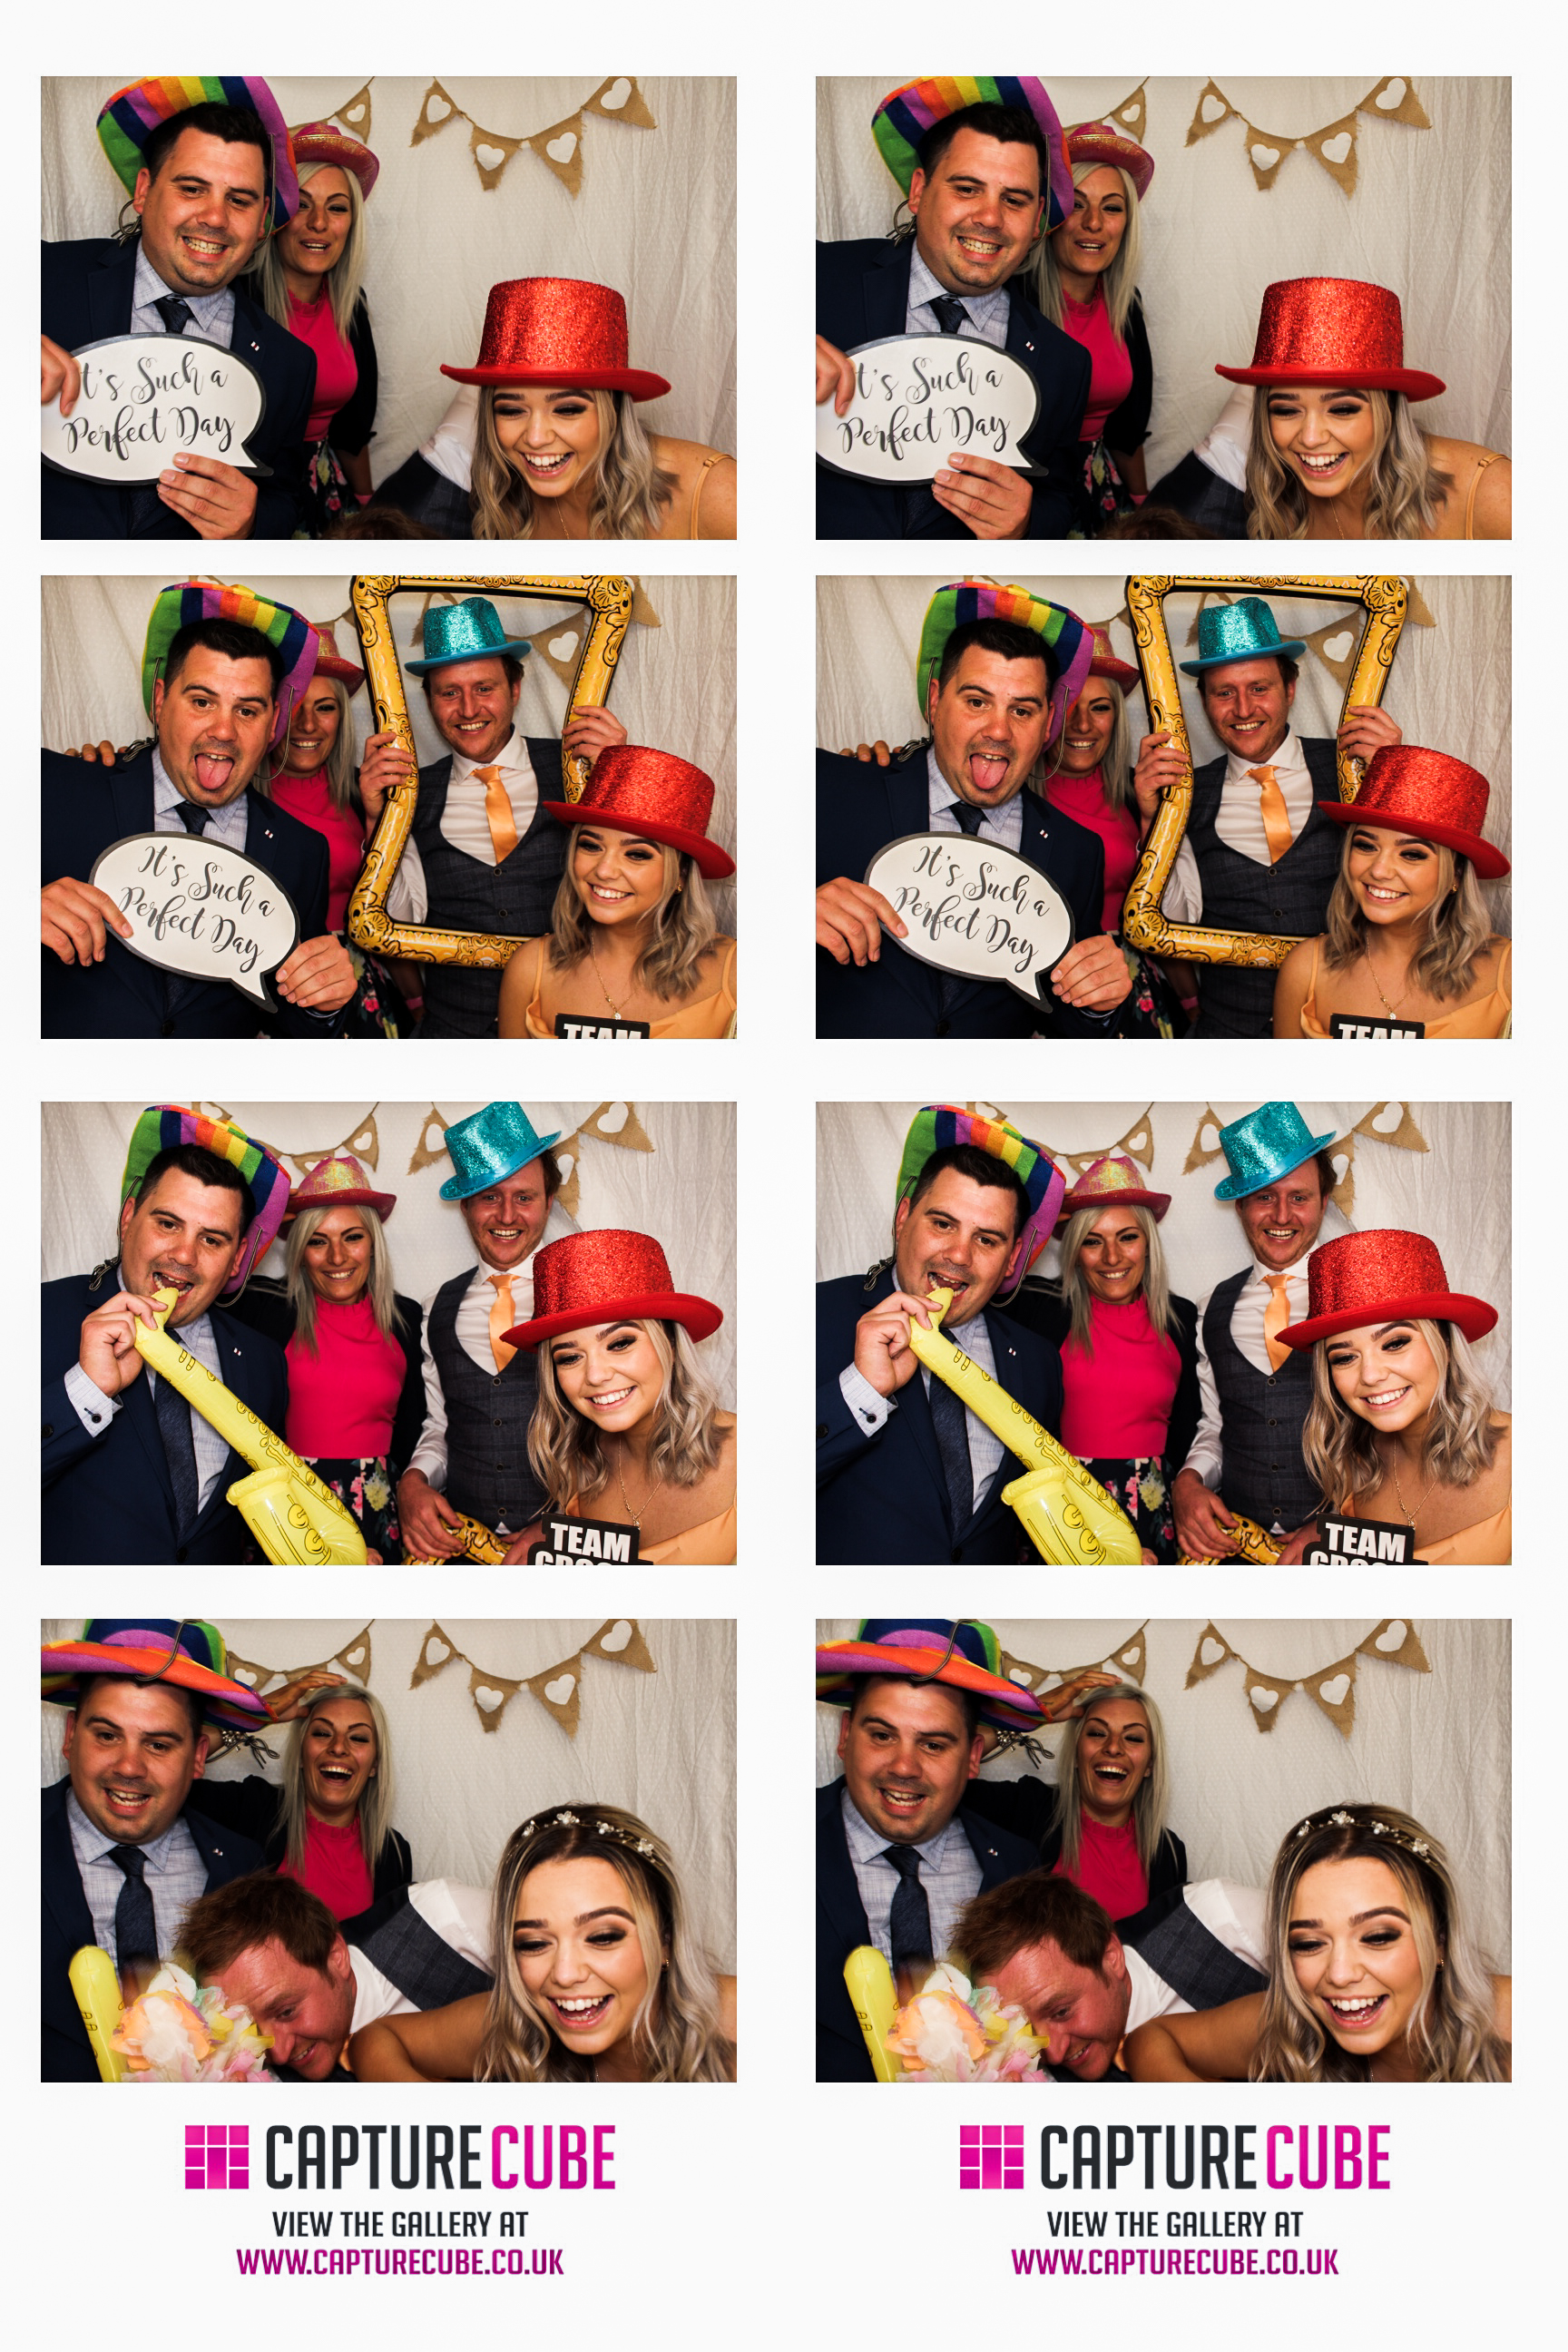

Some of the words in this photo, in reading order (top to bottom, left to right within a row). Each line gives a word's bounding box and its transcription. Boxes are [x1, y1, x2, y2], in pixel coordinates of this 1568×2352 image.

[80, 362, 124, 401] t's
[131, 351, 204, 405] Such
[211, 369, 228, 387] a
[855, 362, 899, 401] t's
[906, 351, 979, 405] Such
[985, 369, 1003, 387] a
[62, 405, 166, 461] Perfect
[168, 406, 236, 453] Day
[837, 405, 941, 461] Perfect
[943, 406, 1011, 453] Day
[137, 845, 189, 887] It's
[188, 861, 255, 915] Such
[259, 899, 275, 916] a
[912, 845, 964, 887] It's
[963, 861, 1030, 915] Such
[1034, 899, 1050, 916] a
[119, 887, 205, 941] Perfect
[211, 914, 264, 974] Day
[894, 887, 980, 941] Perfect
[985, 914, 1039, 974] Day
[550, 1522, 632, 1563] TEAM
[1325, 1522, 1406, 1563] TEAM
